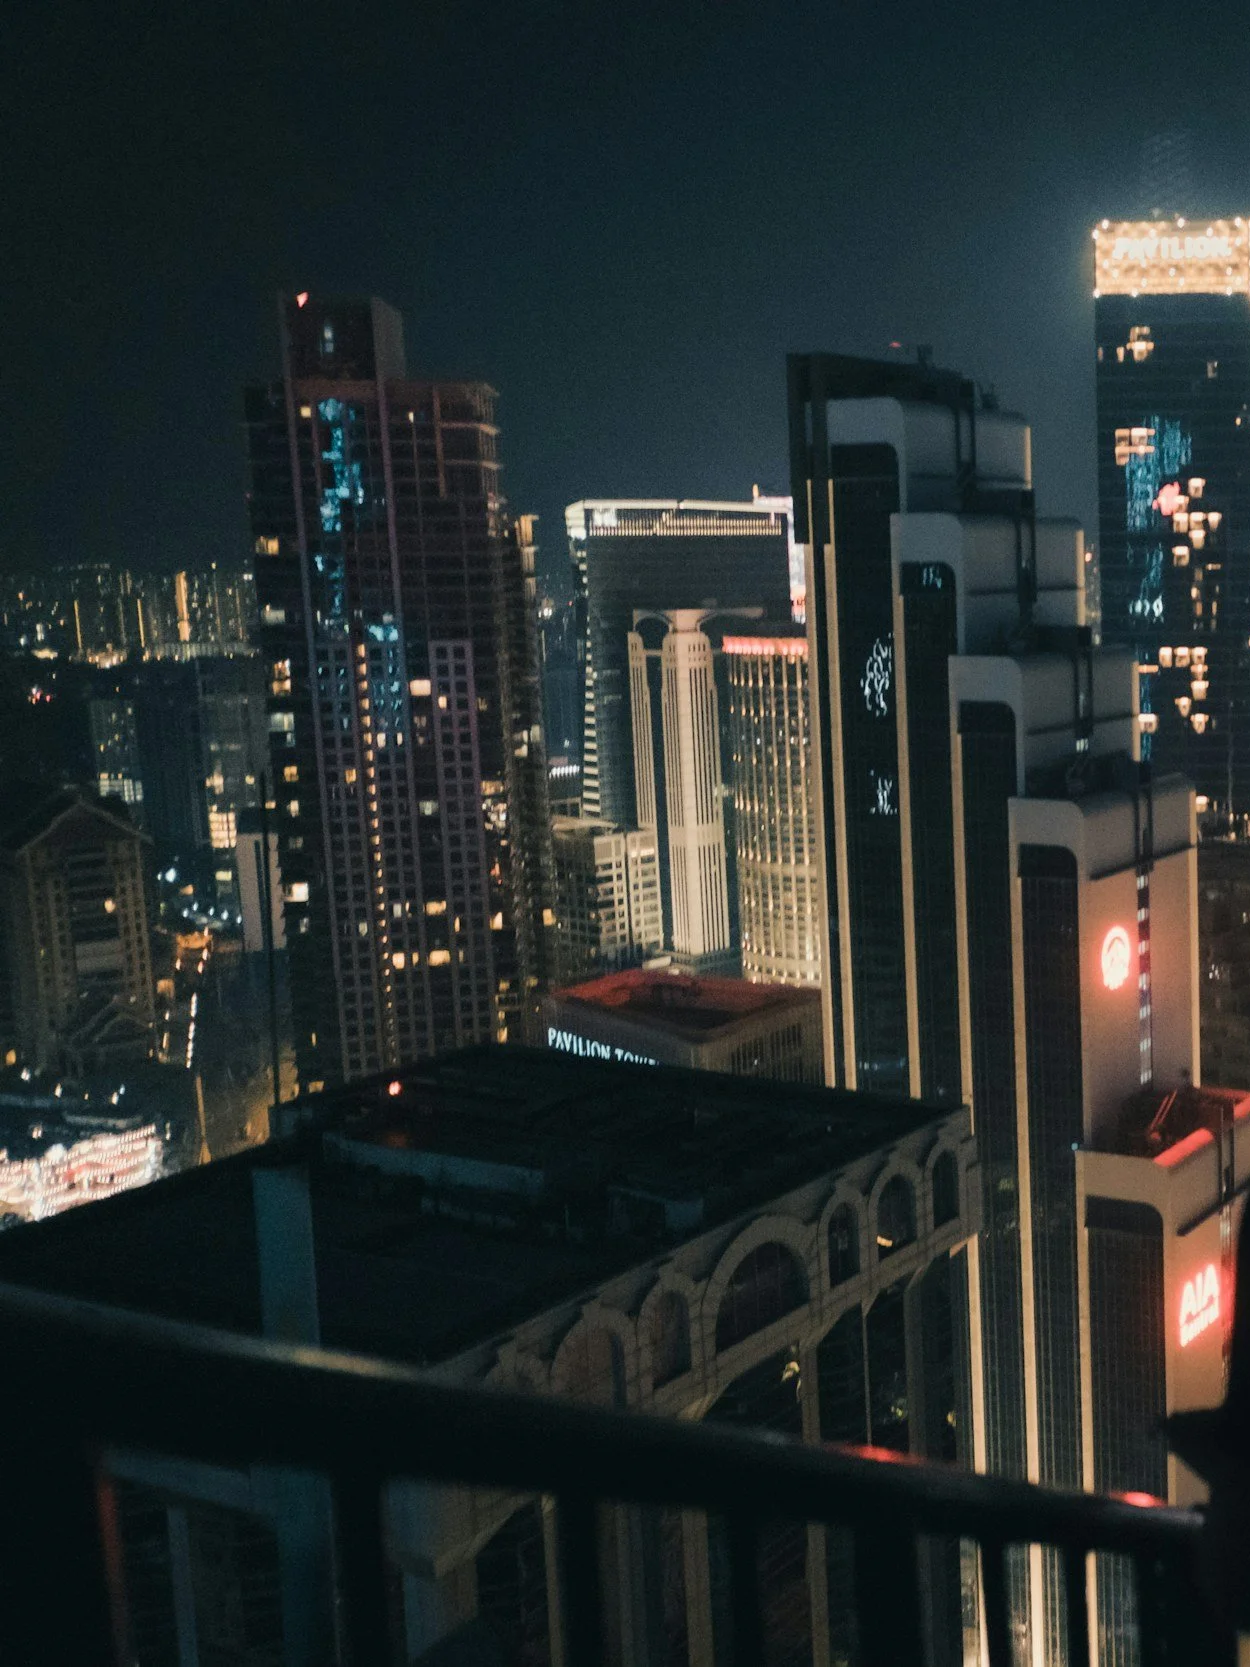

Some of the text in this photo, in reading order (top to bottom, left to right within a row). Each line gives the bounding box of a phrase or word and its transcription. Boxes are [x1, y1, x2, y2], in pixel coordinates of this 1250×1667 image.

[1112, 236, 1232, 260] PAVILION
[547, 1026, 611, 1060] PAVILION
[1179, 1263, 1220, 1326] AIA
